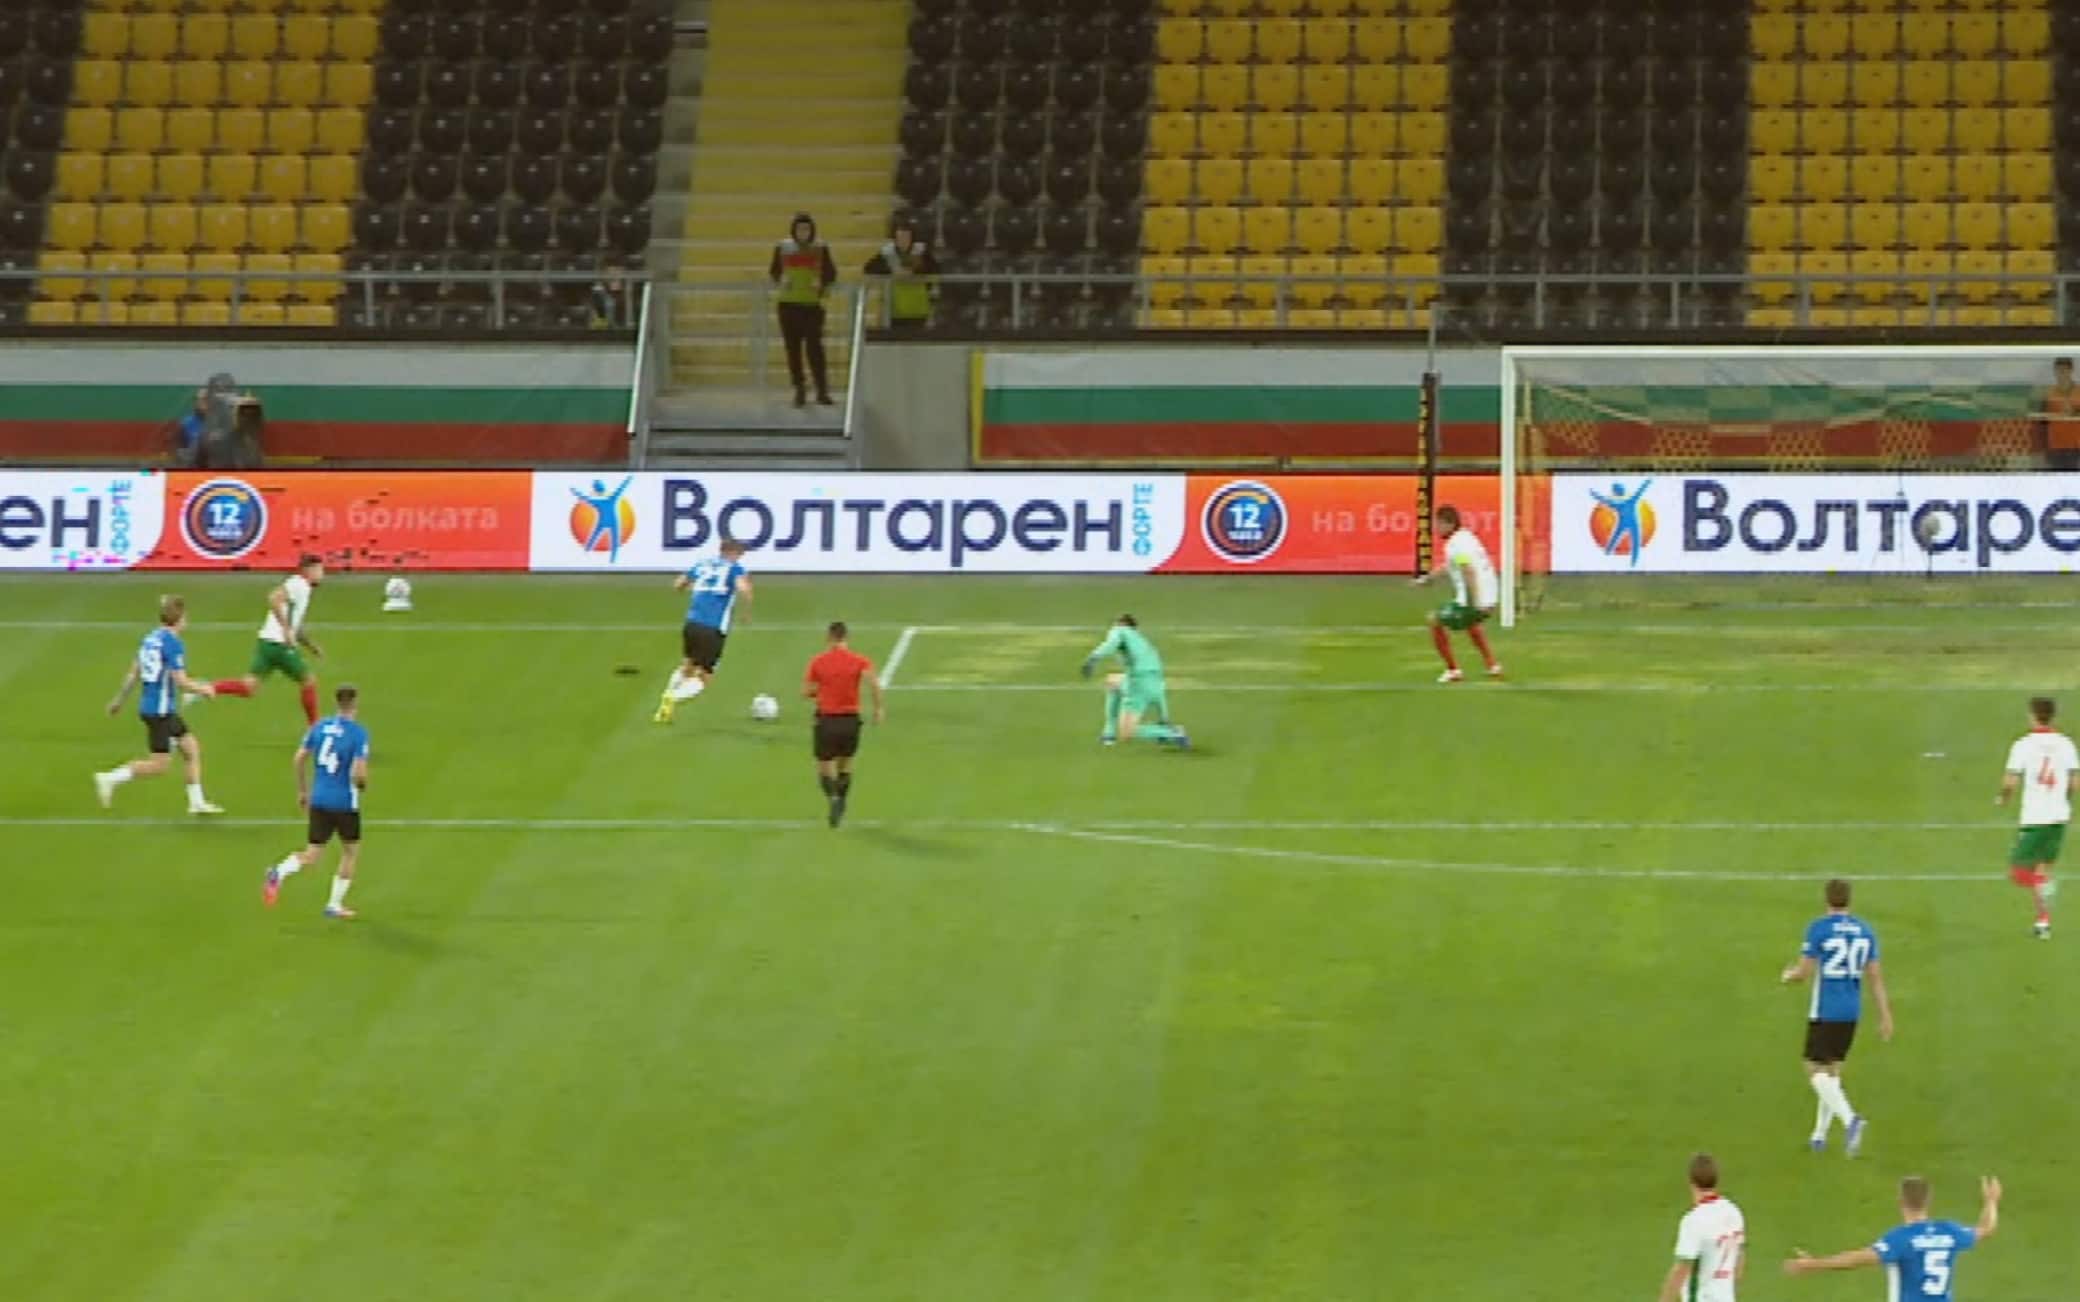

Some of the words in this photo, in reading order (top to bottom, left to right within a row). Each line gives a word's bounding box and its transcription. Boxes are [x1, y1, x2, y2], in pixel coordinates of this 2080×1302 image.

[209, 503, 242, 526] 12
[291, 507, 336, 531] на
[347, 499, 498, 531] болката
[662, 479, 1122, 567] Волтарен
[1229, 503, 1262, 529] 12
[1311, 510, 1355, 533] на
[317, 735, 340, 774] 4
[2037, 757, 2058, 791] 4
[1822, 937, 1871, 980] 20
[1922, 1250, 1951, 1296] 5
